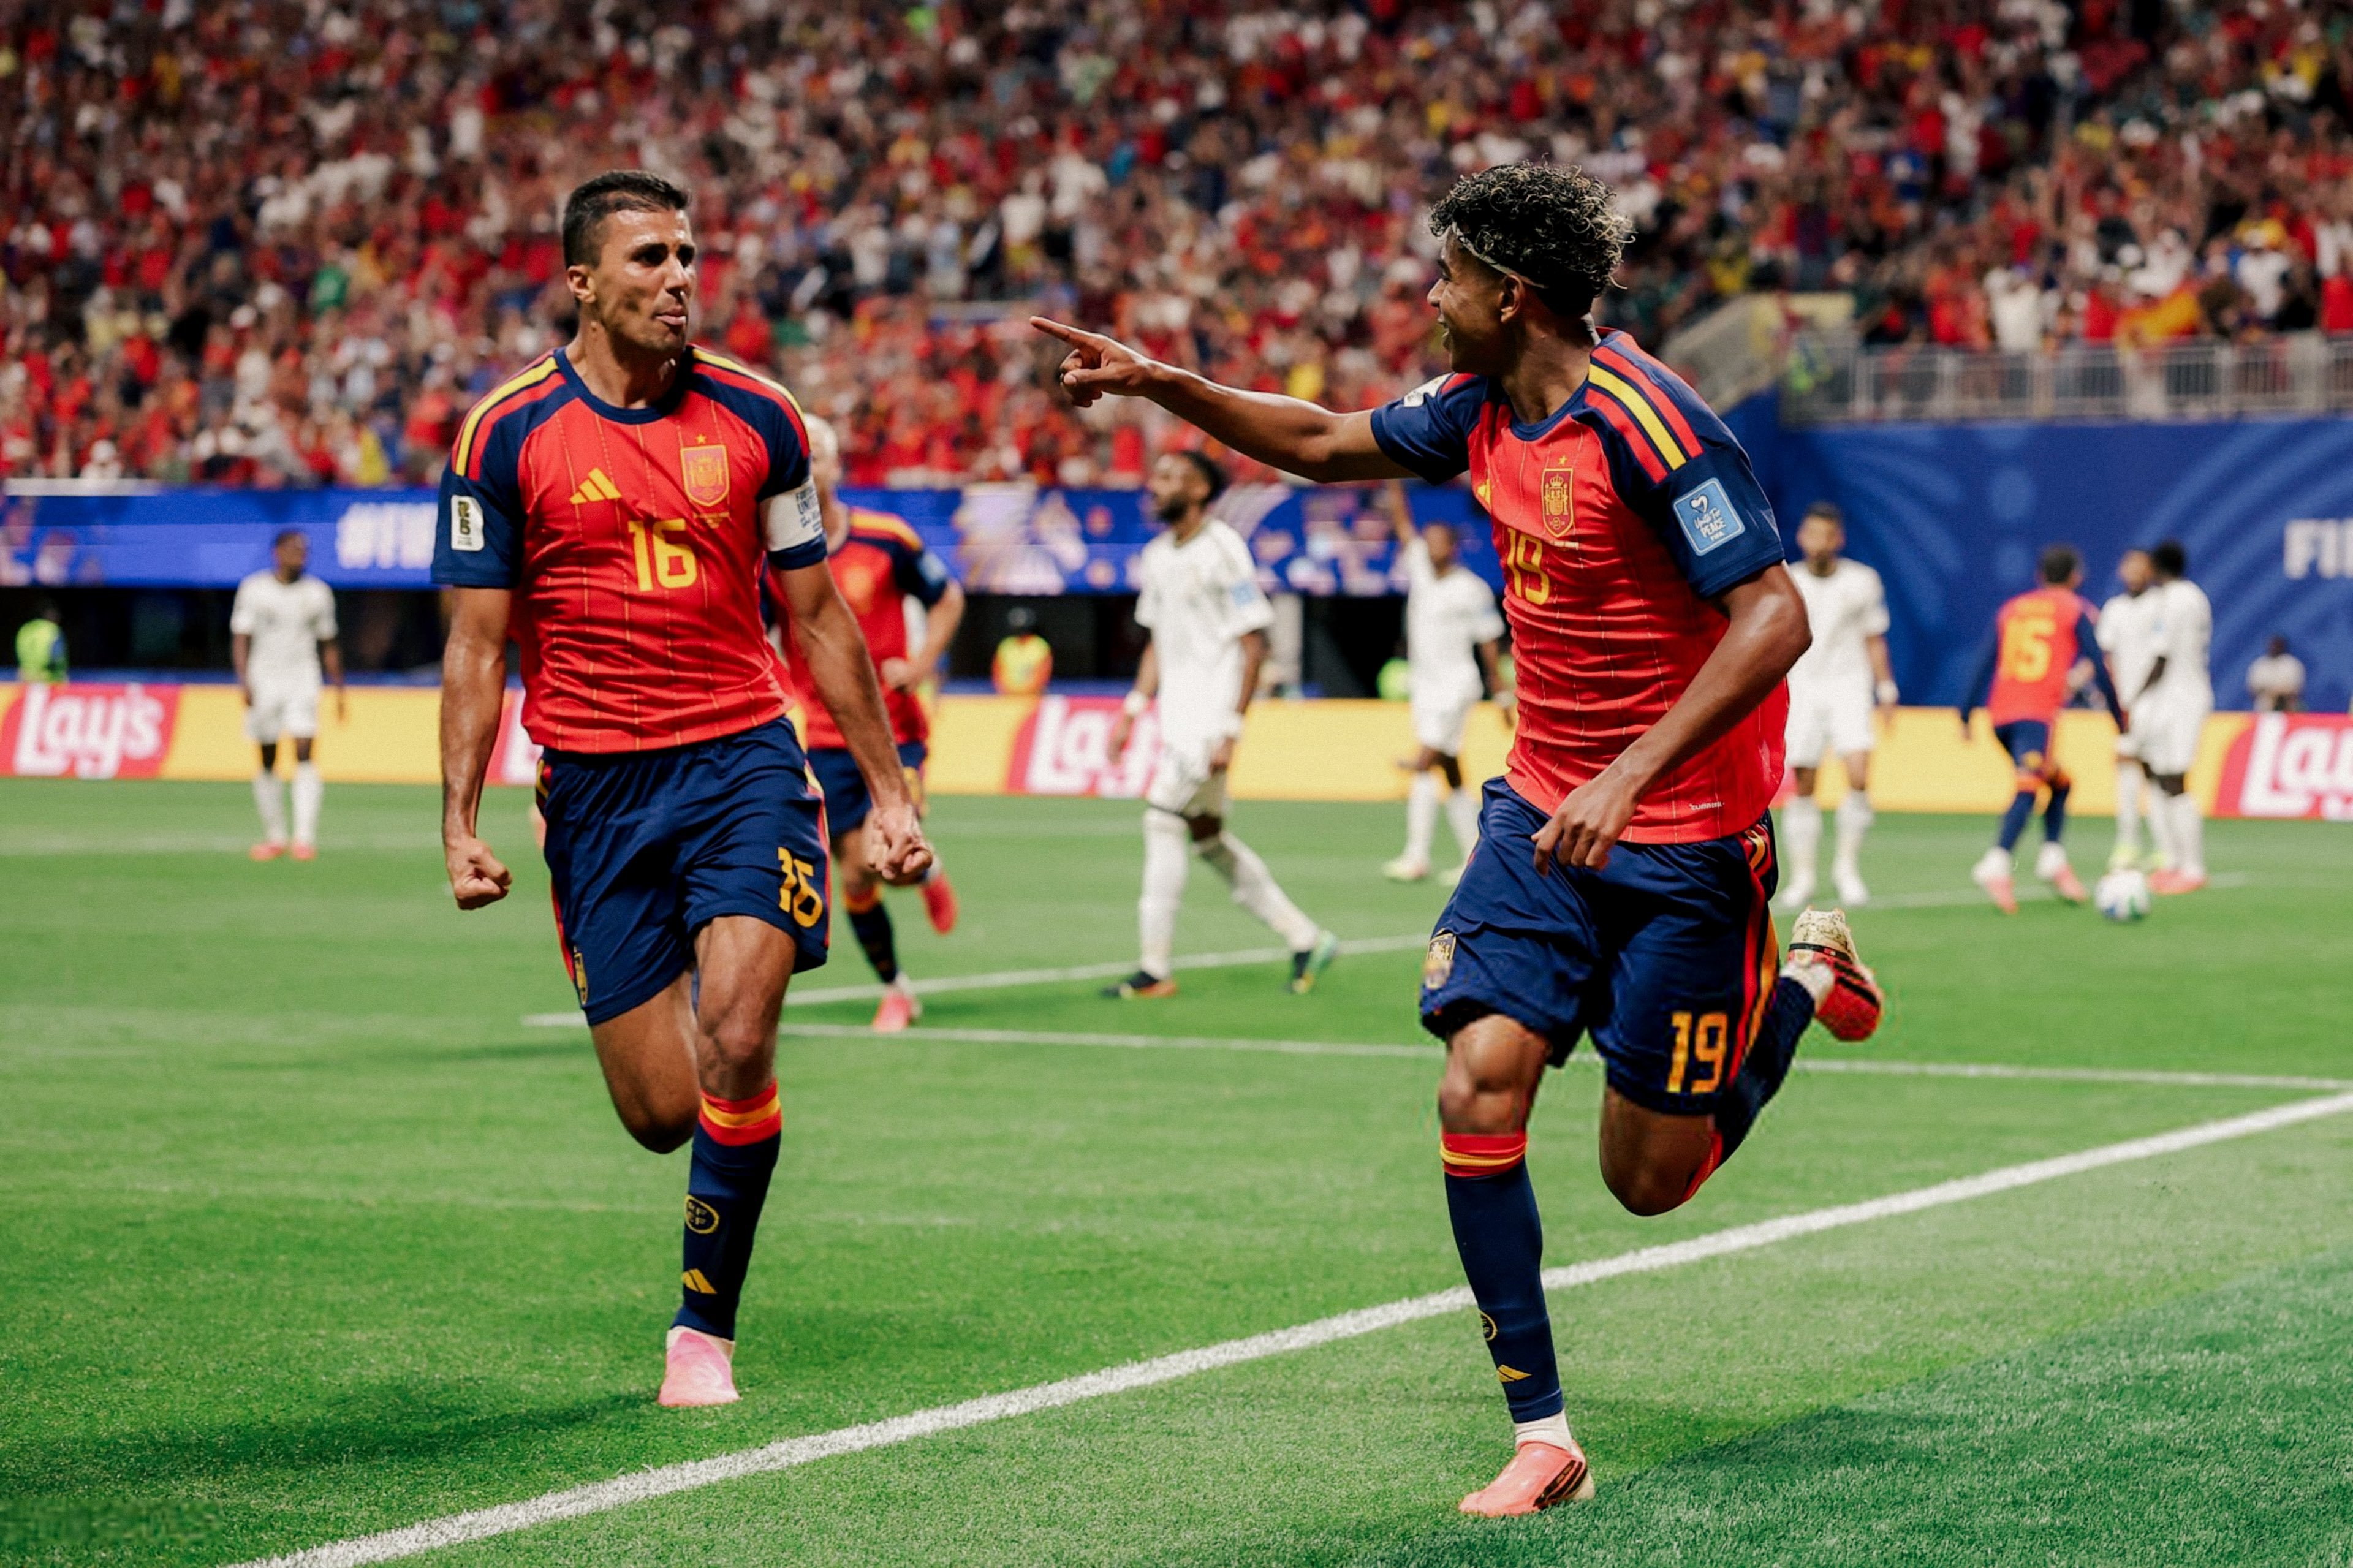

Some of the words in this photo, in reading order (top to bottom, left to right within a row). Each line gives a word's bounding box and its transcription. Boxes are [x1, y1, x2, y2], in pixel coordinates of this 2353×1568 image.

[628, 518, 697, 592] 16
[1507, 526, 1550, 605] 19
[14, 683, 164, 780] Lay's
[1665, 1011, 1727, 1094] 19
